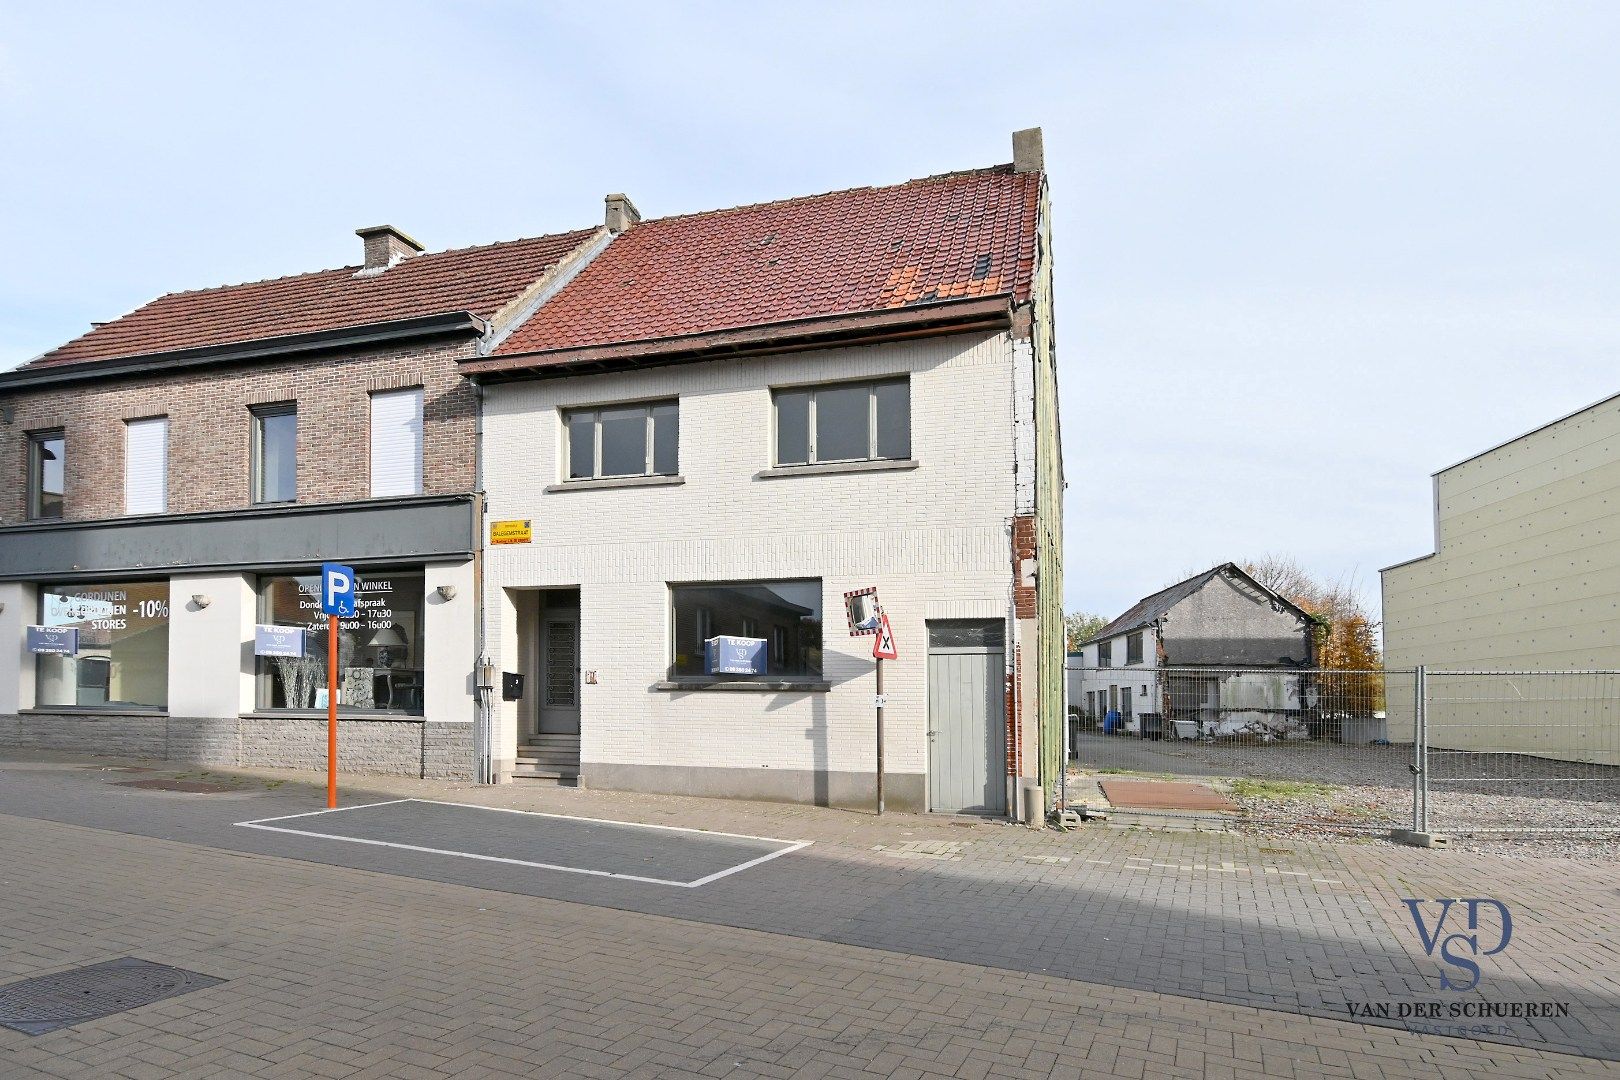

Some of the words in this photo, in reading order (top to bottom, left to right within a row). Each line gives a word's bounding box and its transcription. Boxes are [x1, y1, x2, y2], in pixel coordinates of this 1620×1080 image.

[328, 571, 350, 606] P
[361, 581, 393, 591] WINKEL
[133, 599, 169, 618] -10%
[367, 609, 392, 618] 17u30
[91, 619, 127, 630] STORES
[340, 621, 360, 630] 9u00
[367, 620, 392, 629] 16u00
